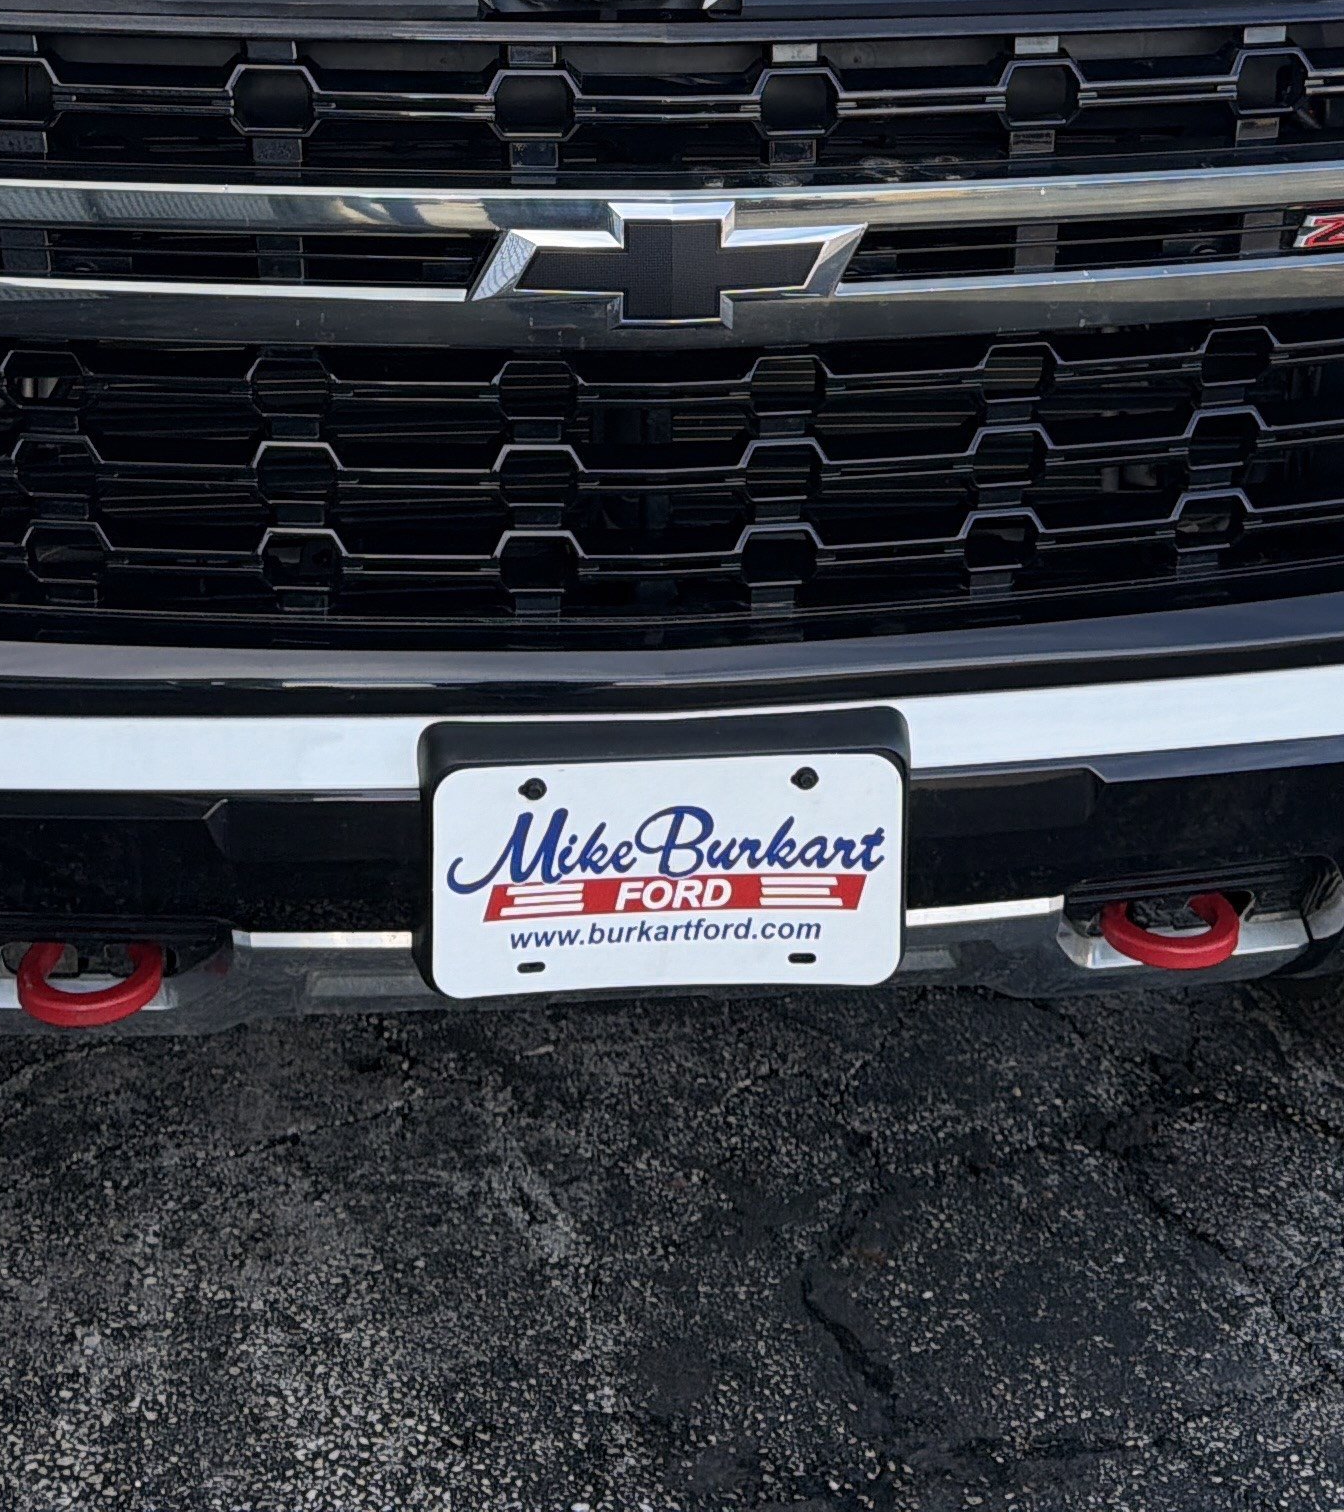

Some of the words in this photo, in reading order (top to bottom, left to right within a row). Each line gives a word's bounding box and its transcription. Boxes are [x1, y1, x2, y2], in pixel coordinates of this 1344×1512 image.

[446, 807, 638, 895] Mike
[634, 805, 886, 879] Burkart
[614, 878, 733, 911] FORD
[509, 916, 822, 950] www.burkartford.com
